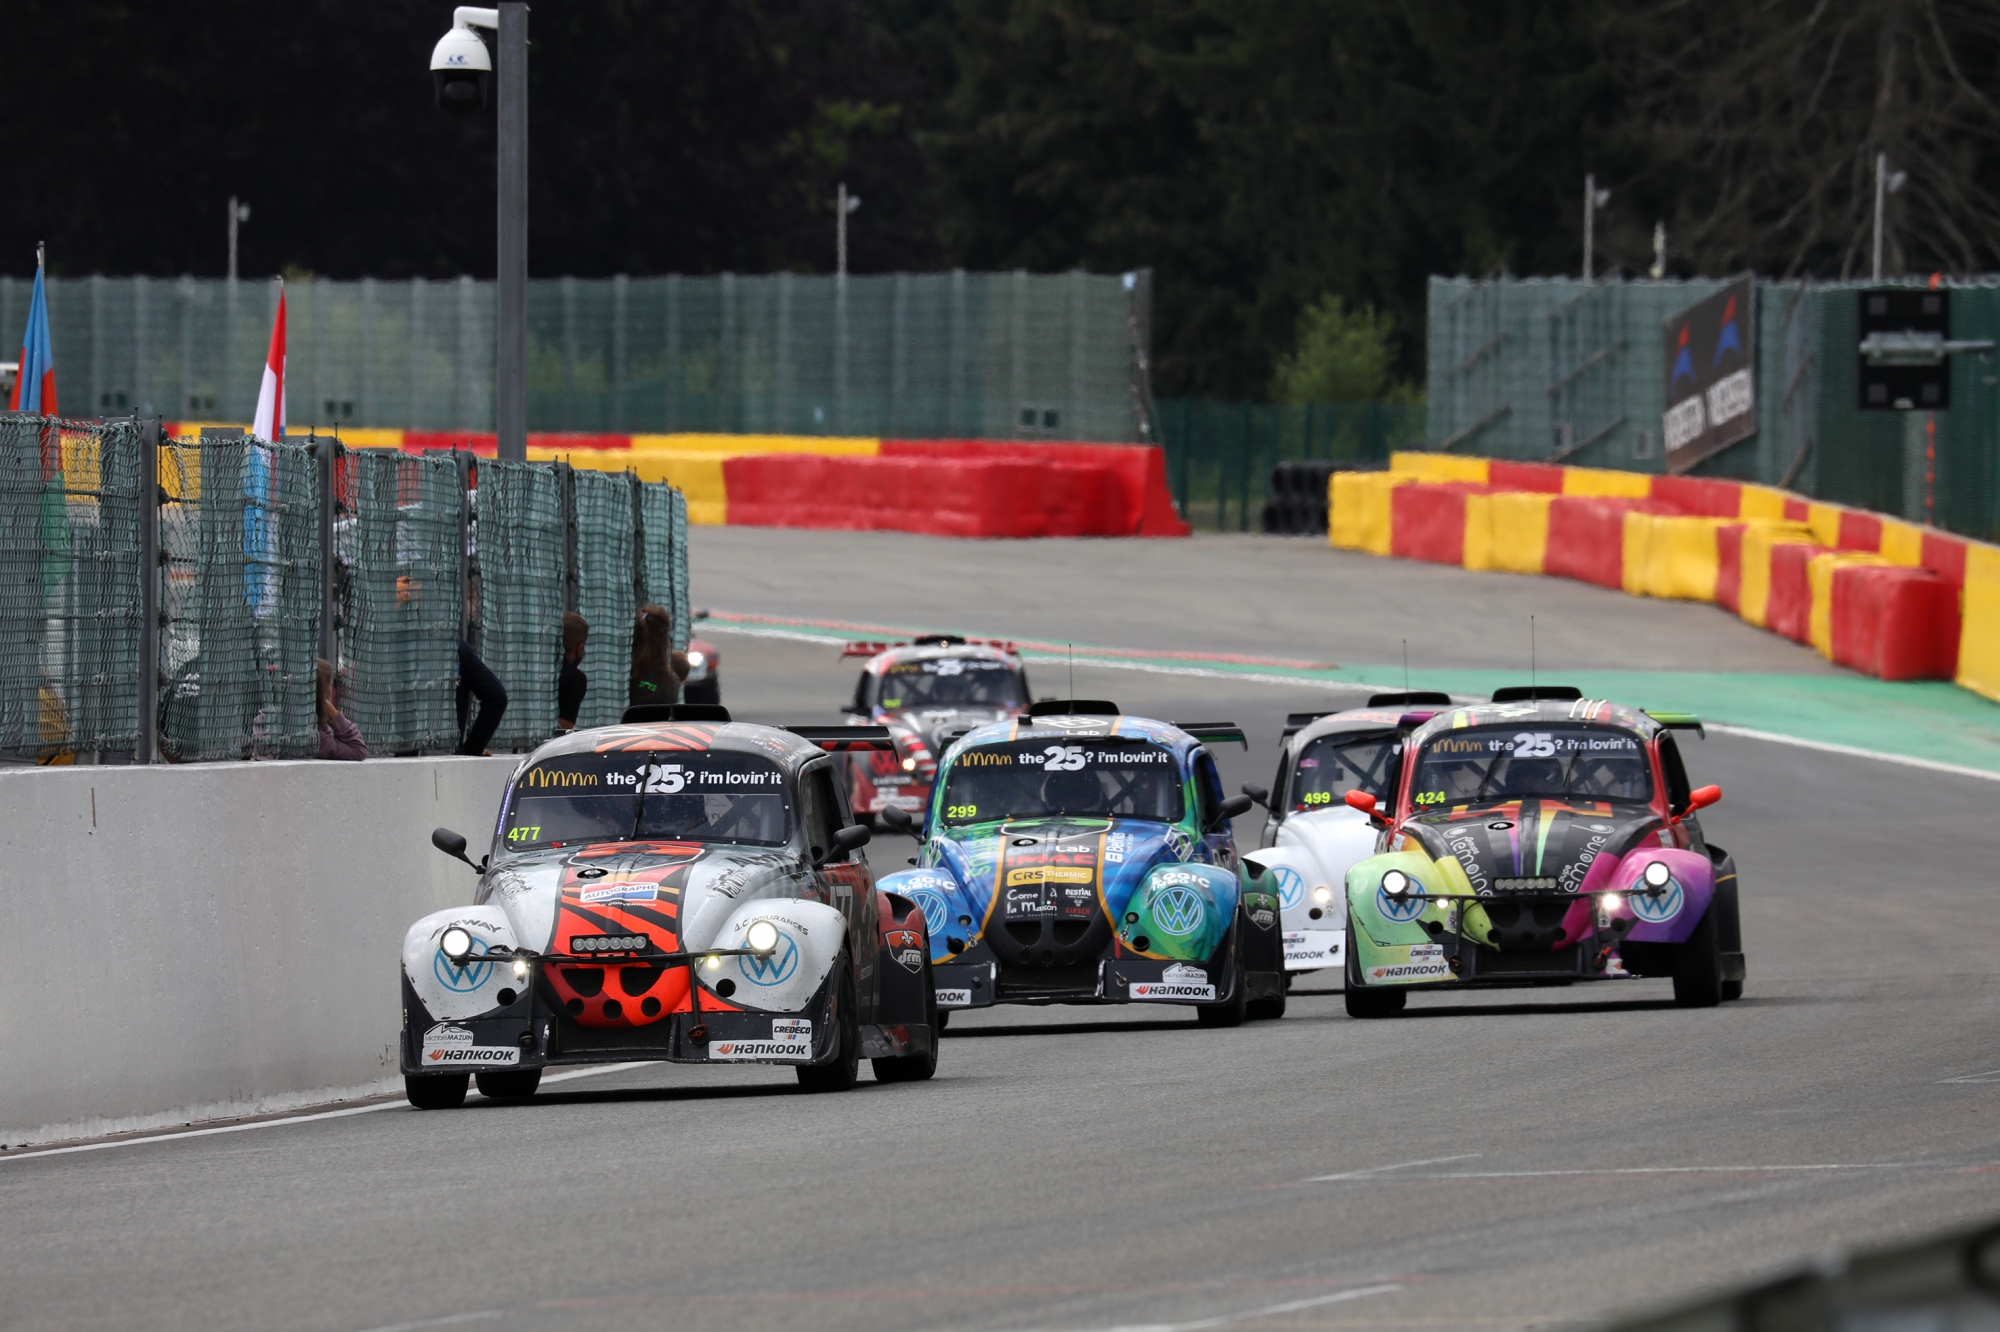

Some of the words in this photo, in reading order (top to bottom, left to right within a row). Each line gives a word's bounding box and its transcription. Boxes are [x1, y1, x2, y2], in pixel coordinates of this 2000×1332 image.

[1488, 740, 1514, 751] the
[1589, 739, 1624, 750] lovin'
[1018, 753, 1045, 765] the
[1098, 752, 1118, 764] i'm
[1120, 752, 1156, 764] lovin'
[1158, 752, 1168, 763] it
[606, 771, 636, 785] the
[700, 771, 725, 785] i'm
[725, 771, 768, 785] lovin'
[771, 771, 782, 785] it
[1303, 792, 1331, 804] 499
[1415, 790, 1446, 805] 424
[947, 805, 977, 818] 299
[508, 827, 541, 841] 477
[1563, 835, 1607, 893] emoine
[1013, 870, 1045, 881] CRS
[1046, 870, 1087, 878] THERMIC
[584, 884, 657, 900] AUTOGRAPHE
[1006, 902, 1017, 913] la
[1021, 901, 1058, 913] Maison
[751, 915, 809, 936] INSURANCES
[774, 1026, 811, 1034] CREDECO
